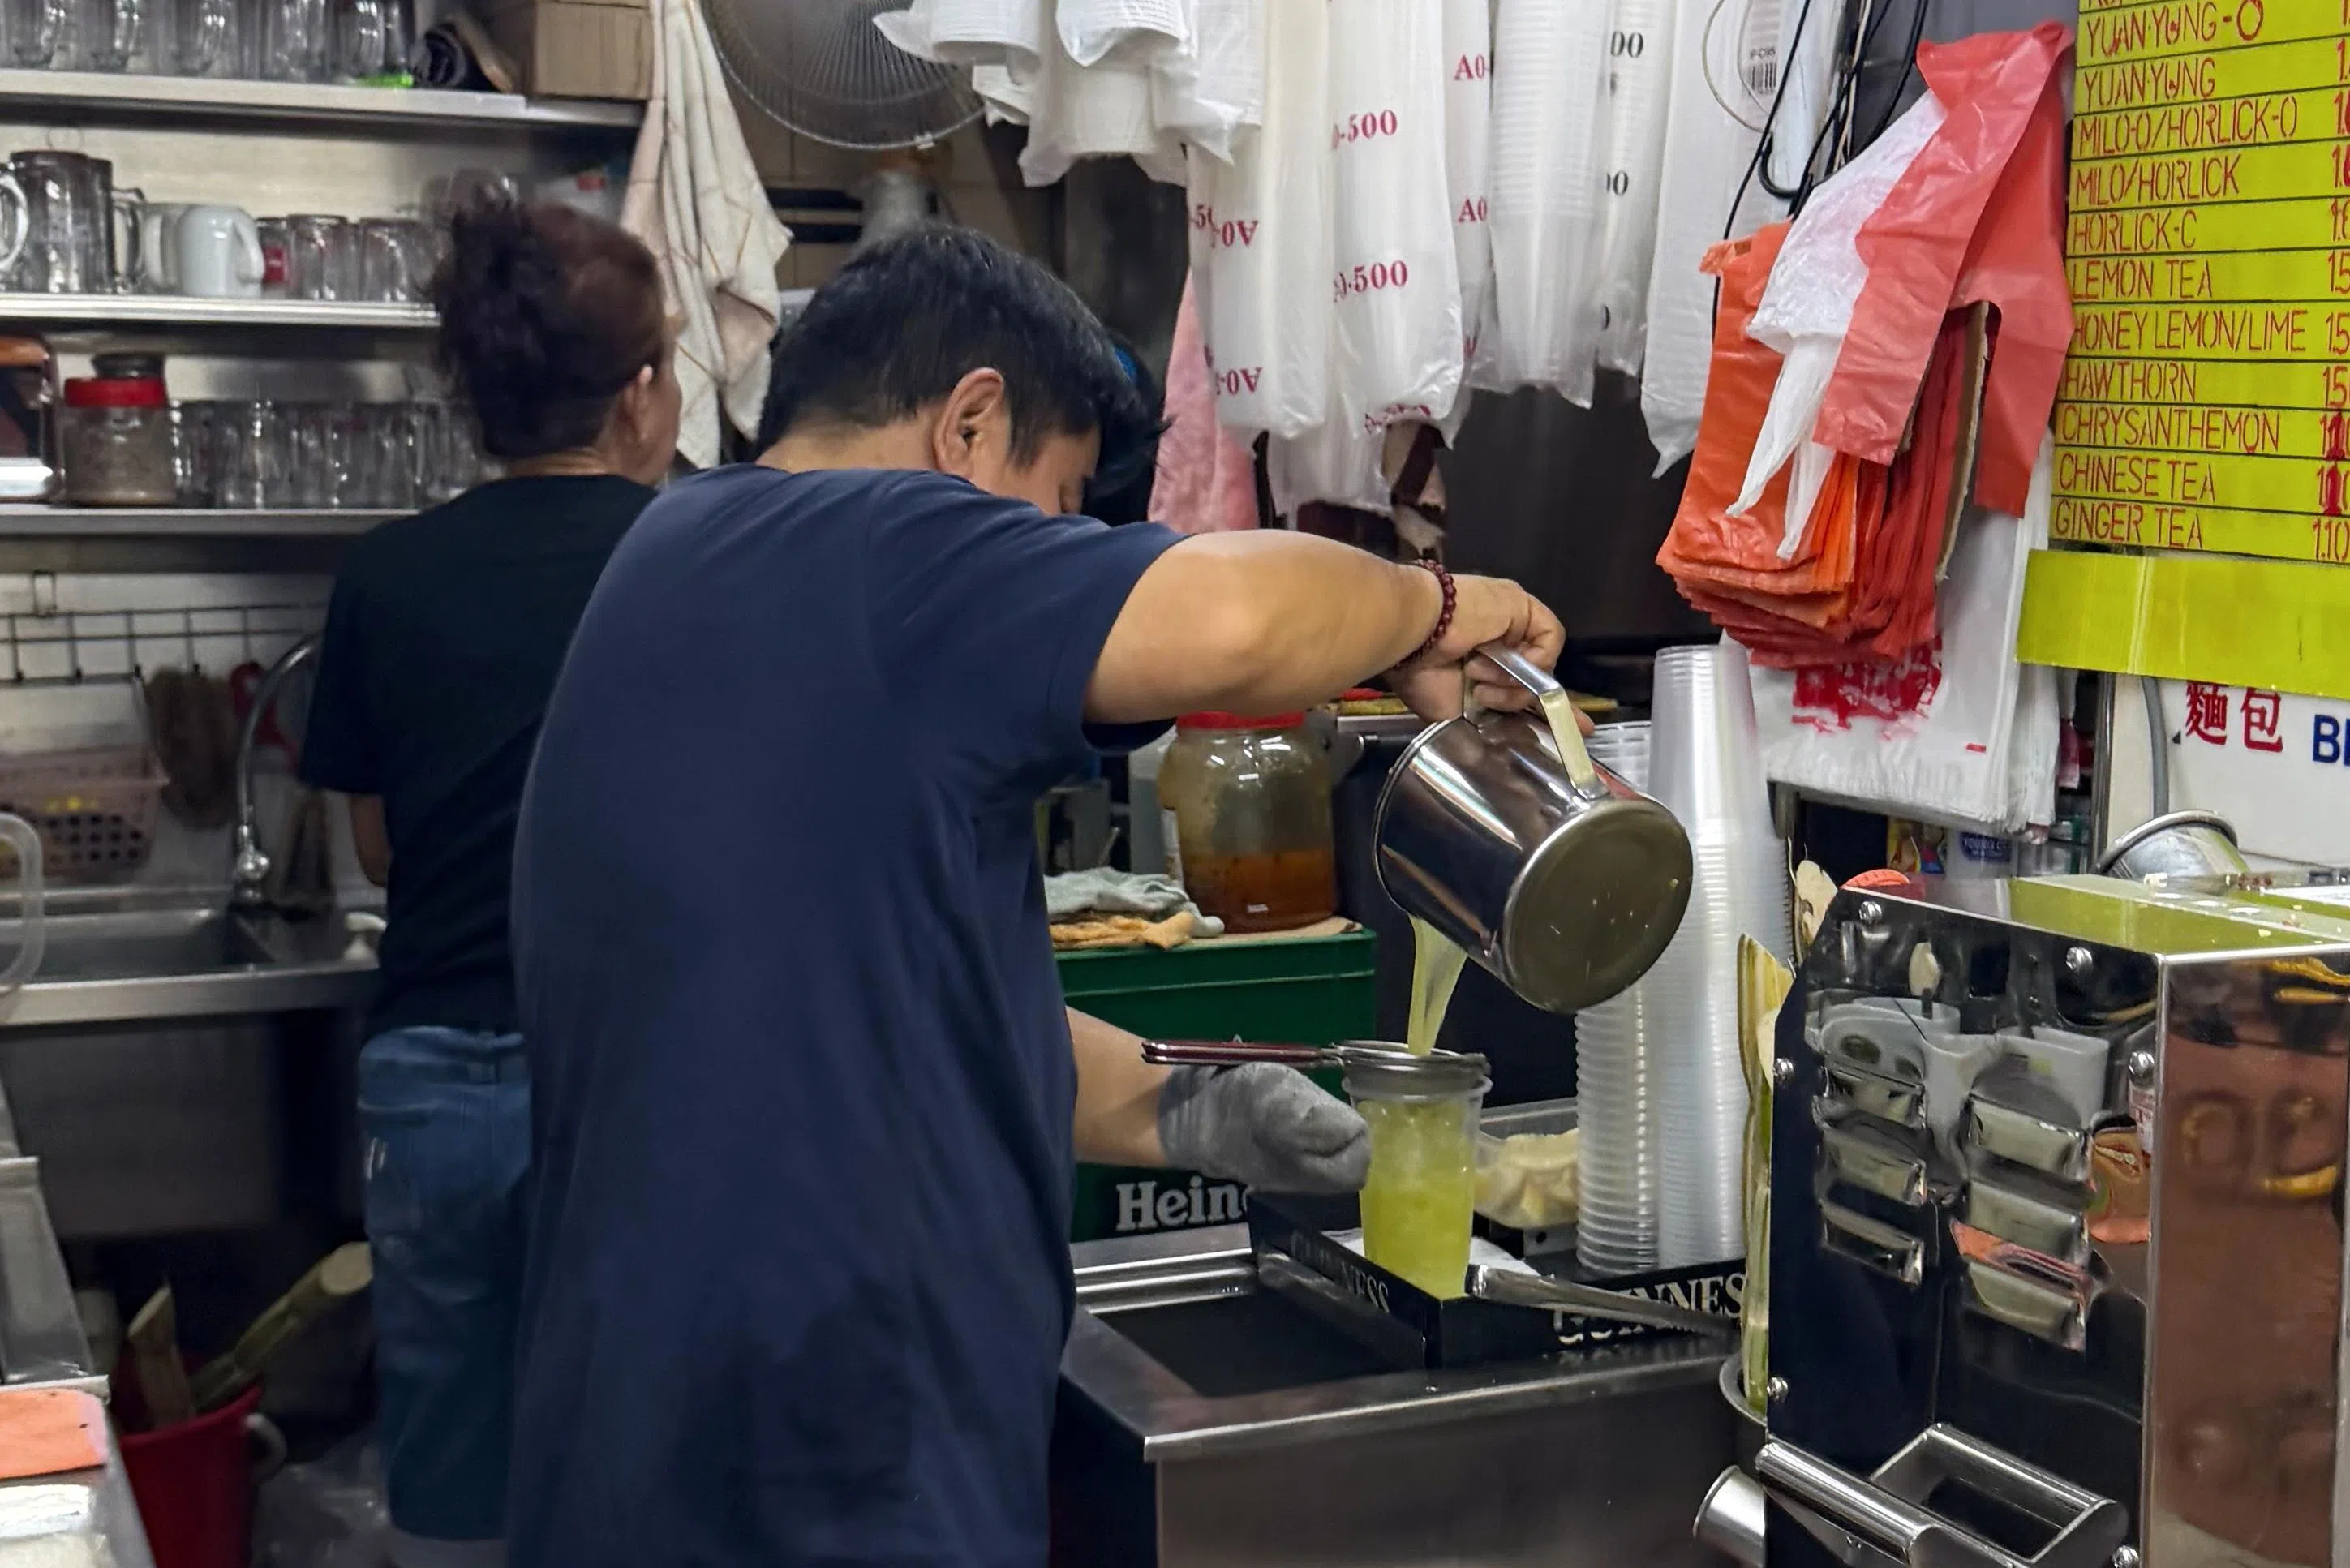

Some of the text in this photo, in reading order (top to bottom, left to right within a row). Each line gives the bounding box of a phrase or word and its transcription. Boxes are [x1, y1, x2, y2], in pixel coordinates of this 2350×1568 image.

[2076, 154, 2241, 205] MILO/HORLICK
[2071, 260, 2154, 299] LEMON
[2166, 259, 2213, 299] TEA
[2073, 311, 2148, 350] HONEY
[2154, 309, 2309, 352] LEMON/LIME
[2065, 362, 2197, 402] HAWTHORN
[2059, 453, 2161, 497] CHINESE
[2167, 460, 2216, 503] TEA
[2056, 499, 2144, 543] GINGER
[2155, 507, 2203, 549] TEA
[2313, 714, 2350, 767] B
[1115, 1175, 1252, 1231] Hein
